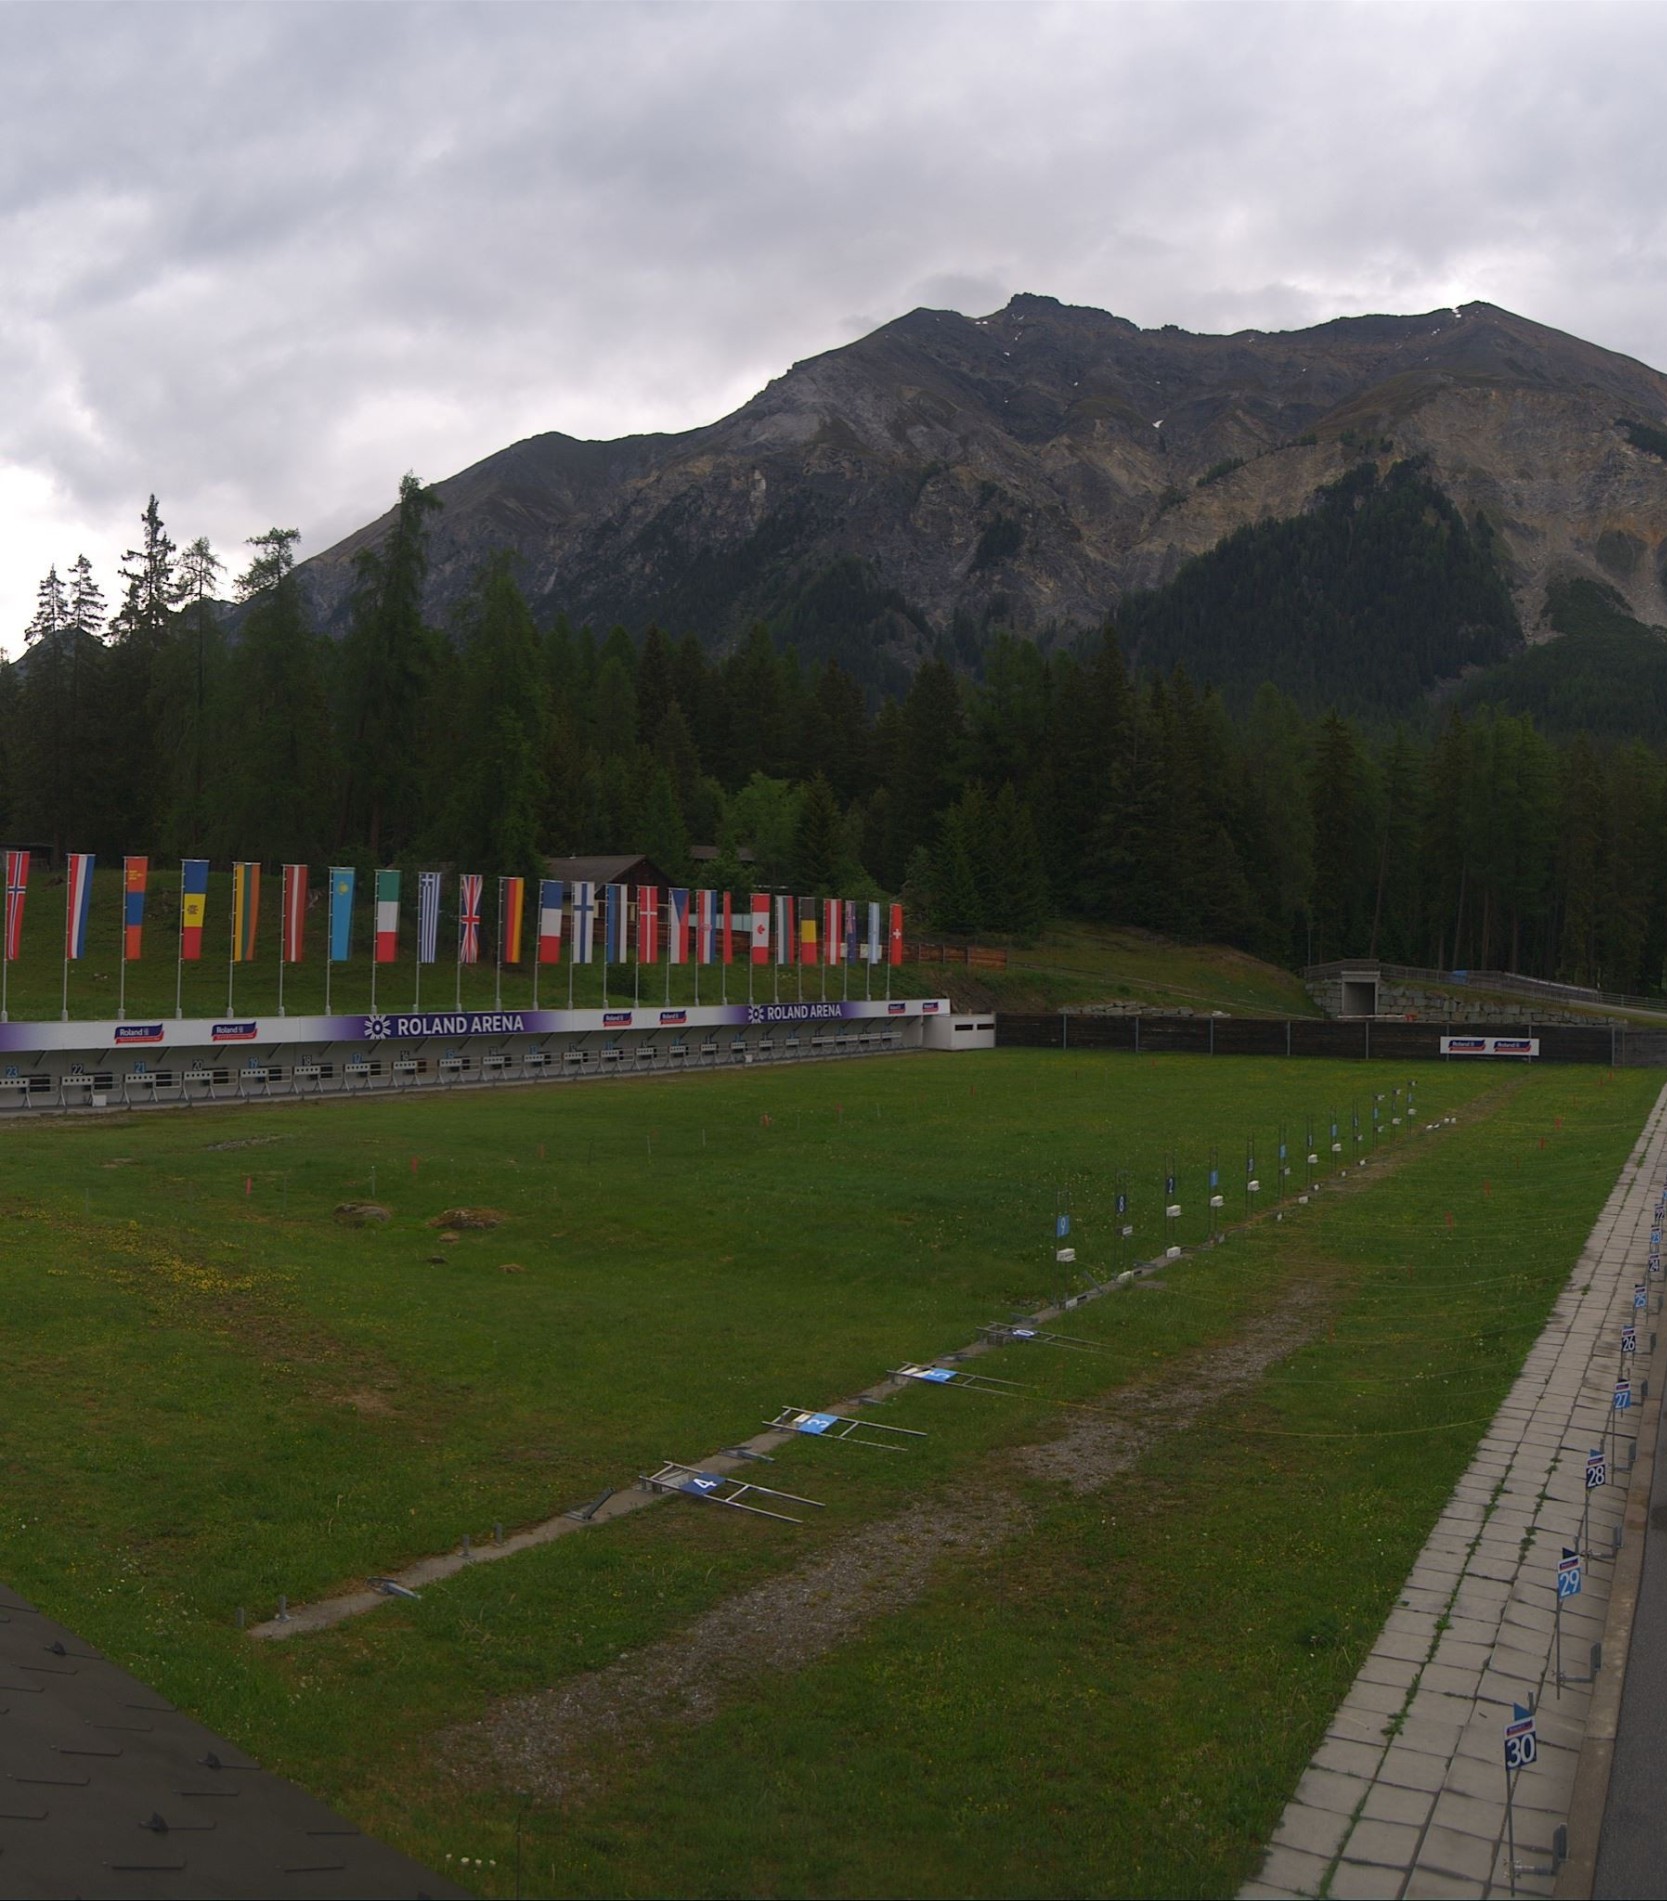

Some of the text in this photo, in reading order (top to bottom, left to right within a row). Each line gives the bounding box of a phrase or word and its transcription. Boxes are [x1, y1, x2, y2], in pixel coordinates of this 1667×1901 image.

[767, 1003, 843, 1020] ROLAND ARENA
[118, 1027, 144, 1037] Roland
[215, 1025, 240, 1036] Roland
[397, 1014, 525, 1037] ROLAND ARENA
[6, 1066, 18, 1077] 23
[72, 1064, 84, 1075] 22
[1622, 1335, 1636, 1352] 26
[1614, 1391, 1629, 1410] 27
[807, 1417, 831, 1431] 3
[692, 1477, 718, 1491] 4
[1587, 1465, 1605, 1488] 28
[1559, 1568, 1581, 1598] 29
[1506, 1732, 1536, 1769] 30
